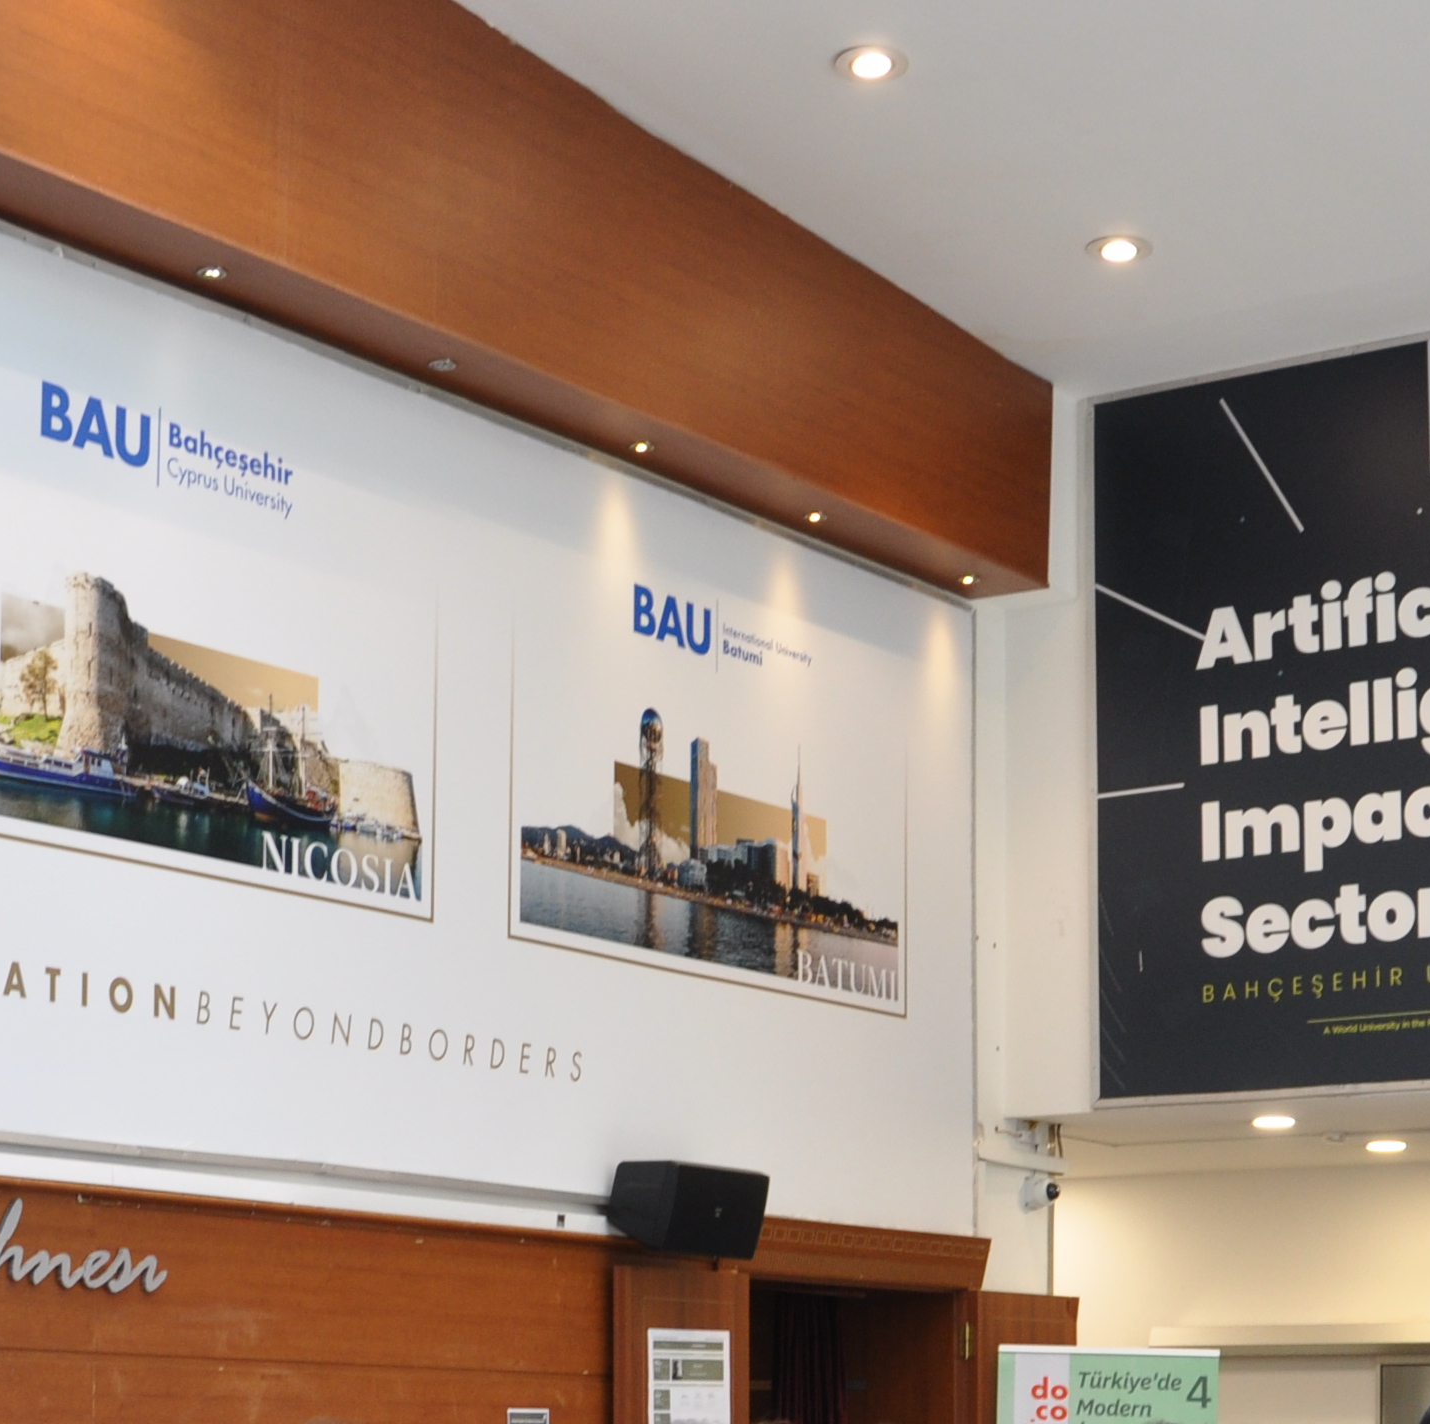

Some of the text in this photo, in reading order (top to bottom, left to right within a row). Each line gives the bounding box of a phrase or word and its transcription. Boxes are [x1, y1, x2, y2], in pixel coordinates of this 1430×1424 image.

[40, 380, 151, 468] BAU
[169, 421, 294, 485] Bahçeşehir
[167, 457, 294, 520] Cyprus University
[633, 583, 711, 656] BAU
[722, 622, 813, 668] International University
[722, 639, 763, 667] Batumi
[261, 830, 419, 902] NICOSIA
[796, 948, 897, 1001] BATUMI
[1202, 963, 1403, 1004] BAHÇEŞEHİR
[1332, 1023, 1358, 1035] World
[1359, 1021, 1401, 1033] University
[1411, 1018, 1425, 1029] the
[1031, 1376, 1068, 1400] do
[1076, 1398, 1152, 1418] Modern
[1079, 1371, 1212, 1409] Türkiye'de 4
[1036, 1405, 1068, 1421] co
